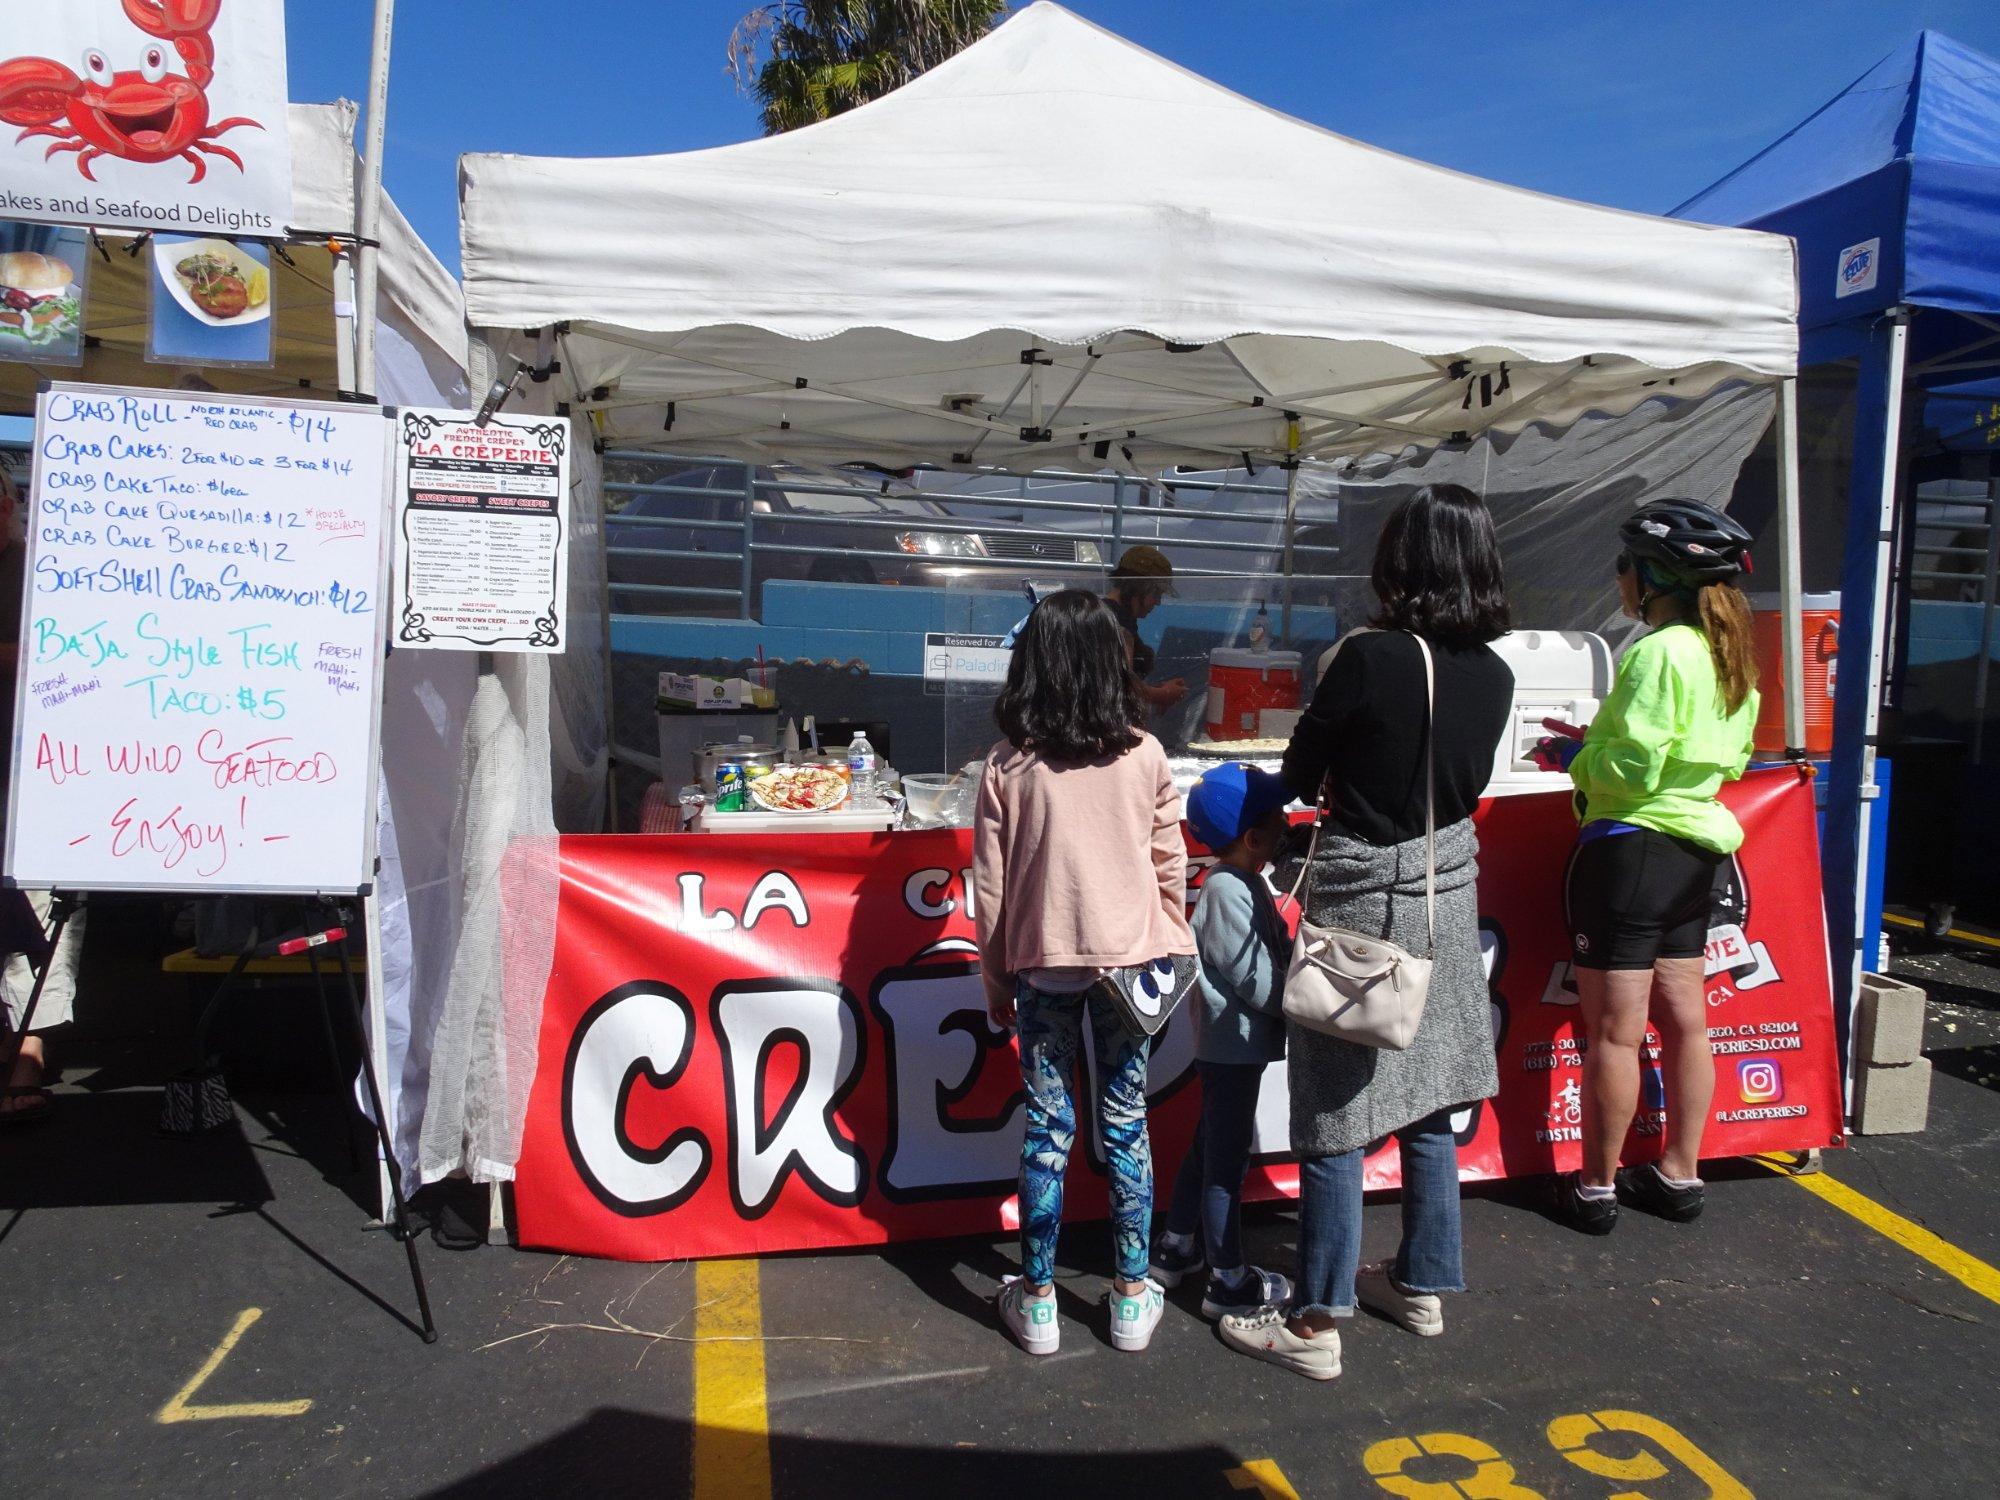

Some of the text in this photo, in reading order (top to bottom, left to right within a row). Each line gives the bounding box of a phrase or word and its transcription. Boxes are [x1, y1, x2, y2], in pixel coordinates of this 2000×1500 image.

[0, 190, 272, 230] akes and Seafood Delights
[49, 394, 114, 423] CRAB
[229, 407, 275, 419] ATLANTIC
[288, 409, 336, 442] $14
[204, 416, 258, 431] RED CRAB
[444, 434, 483, 443] FRENCH
[456, 428, 513, 437] AUTHENTIC
[44, 434, 102, 465] CRAB
[107, 435, 173, 461] CAKES:
[220, 452, 245, 467] $10
[275, 456, 290, 470] 3
[295, 459, 318, 470] FOR
[321, 457, 354, 475] $14
[417, 443, 442, 456] LA
[48, 472, 96, 492] CRAB
[104, 471, 152, 493] CAKE
[153, 476, 201, 494] TACO:
[416, 493, 448, 502] SAVORY
[488, 497, 517, 506] SWEET
[517, 499, 549, 508] CREPES
[43, 500, 96, 525] CRAB
[104, 501, 149, 519] CAKE
[263, 512, 306, 528] $12
[315, 519, 366, 531] SPECIALTY
[42, 528, 97, 545] CRAB
[106, 526, 156, 550] CAKE
[249, 538, 295, 562] $12
[36, 555, 98, 593] SOFT
[170, 563, 221, 601] CRAB
[329, 581, 374, 613] $12
[34, 618, 129, 668] BAJA
[228, 624, 302, 671] FISH
[319, 642, 362, 659] FRESH
[945, 637, 996, 647] Reserved for
[32, 672, 68, 695] FRESH
[124, 674, 286, 720] TACO: $5
[197, 729, 337, 789] SEAFOOD
[716, 778, 743, 798] Sprite
[677, 869, 809, 931] LA
[1706, 1022, 1799, 1038] IEGO, CA 92104
[1711, 1036, 1801, 1054] PERIESD.COM
[1561, 1054, 1584, 1067] 79
[1716, 1105, 1808, 1121] @LACREPERIESD
[1536, 1127, 1582, 1142] POSTM
